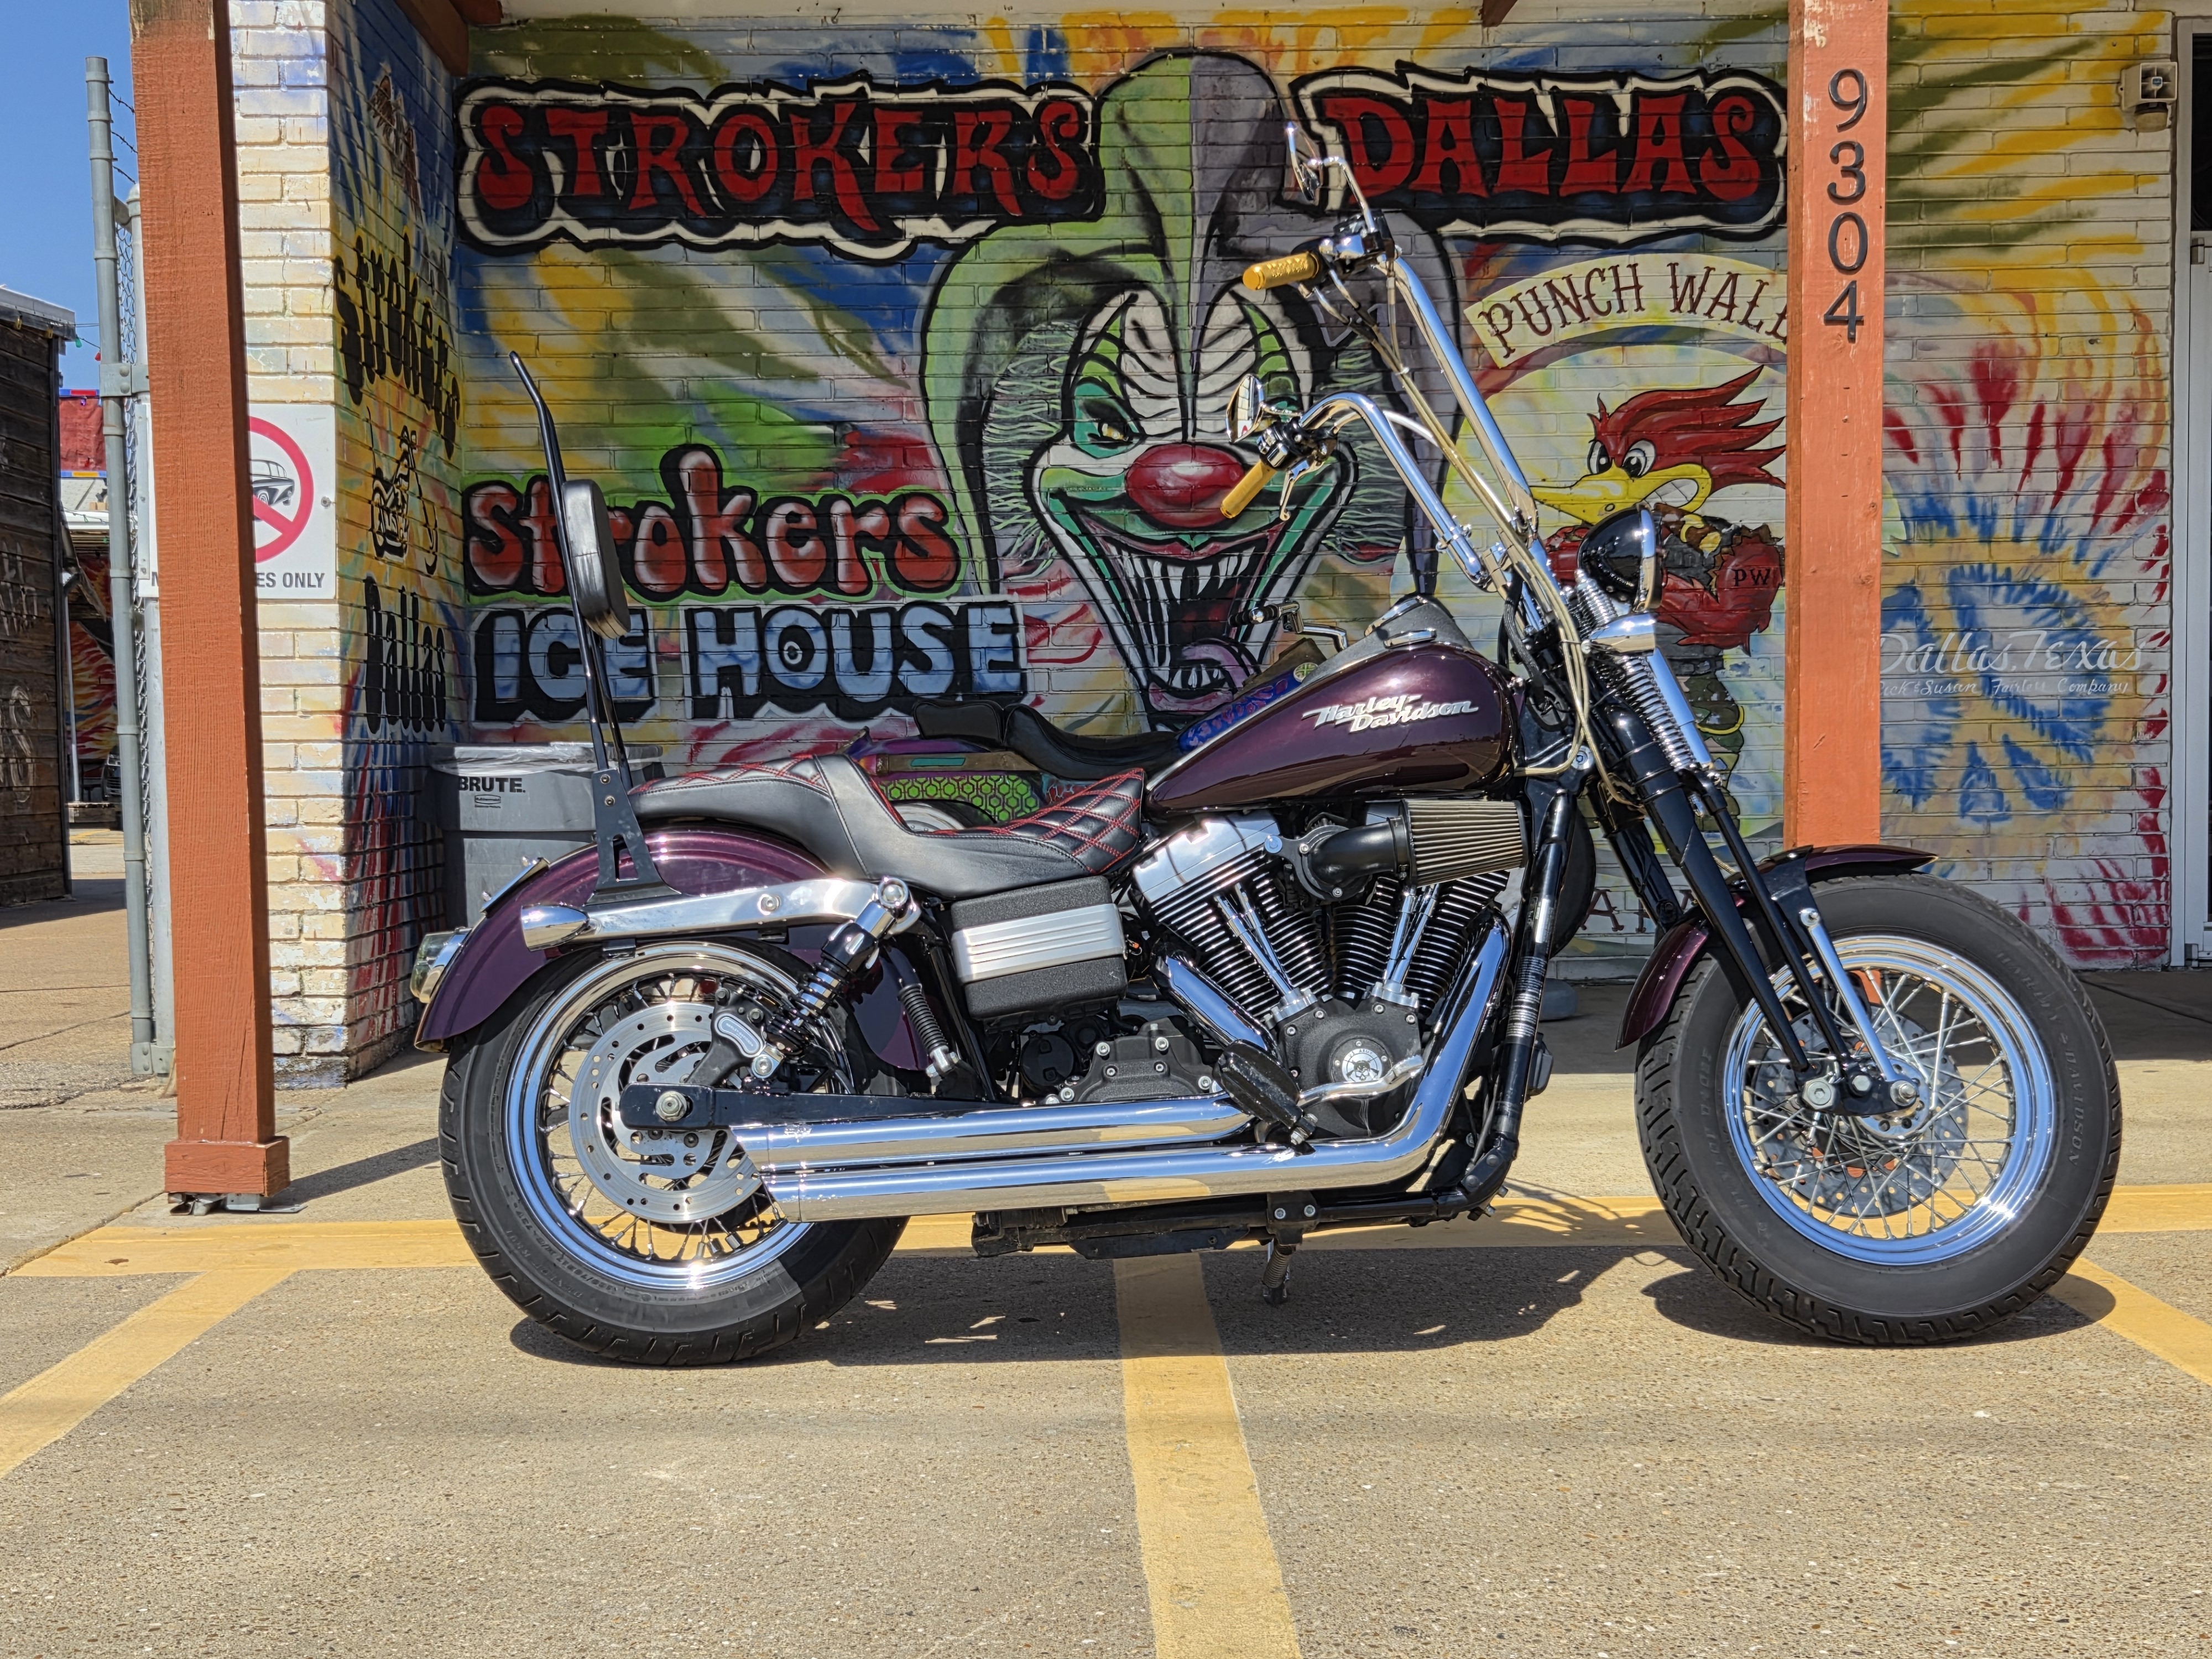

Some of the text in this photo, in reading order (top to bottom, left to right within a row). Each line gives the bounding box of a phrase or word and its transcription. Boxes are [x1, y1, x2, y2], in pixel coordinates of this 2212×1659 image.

[477, 102, 1081, 231] STROKERS
[1322, 93, 1761, 202] DALLAS
[1823, 67, 1868, 344] 9304
[1477, 262, 1646, 358] PUNCH
[283, 572, 325, 588] ONLY
[1733, 568, 1771, 587] PW
[492, 603, 1023, 703] ICE HOUSE
[2008, 630, 2147, 671] Texas
[1334, 700, 1479, 734] Davidson
[1920, 680, 1979, 696] Susan
[2057, 677, 2129, 695] Company
